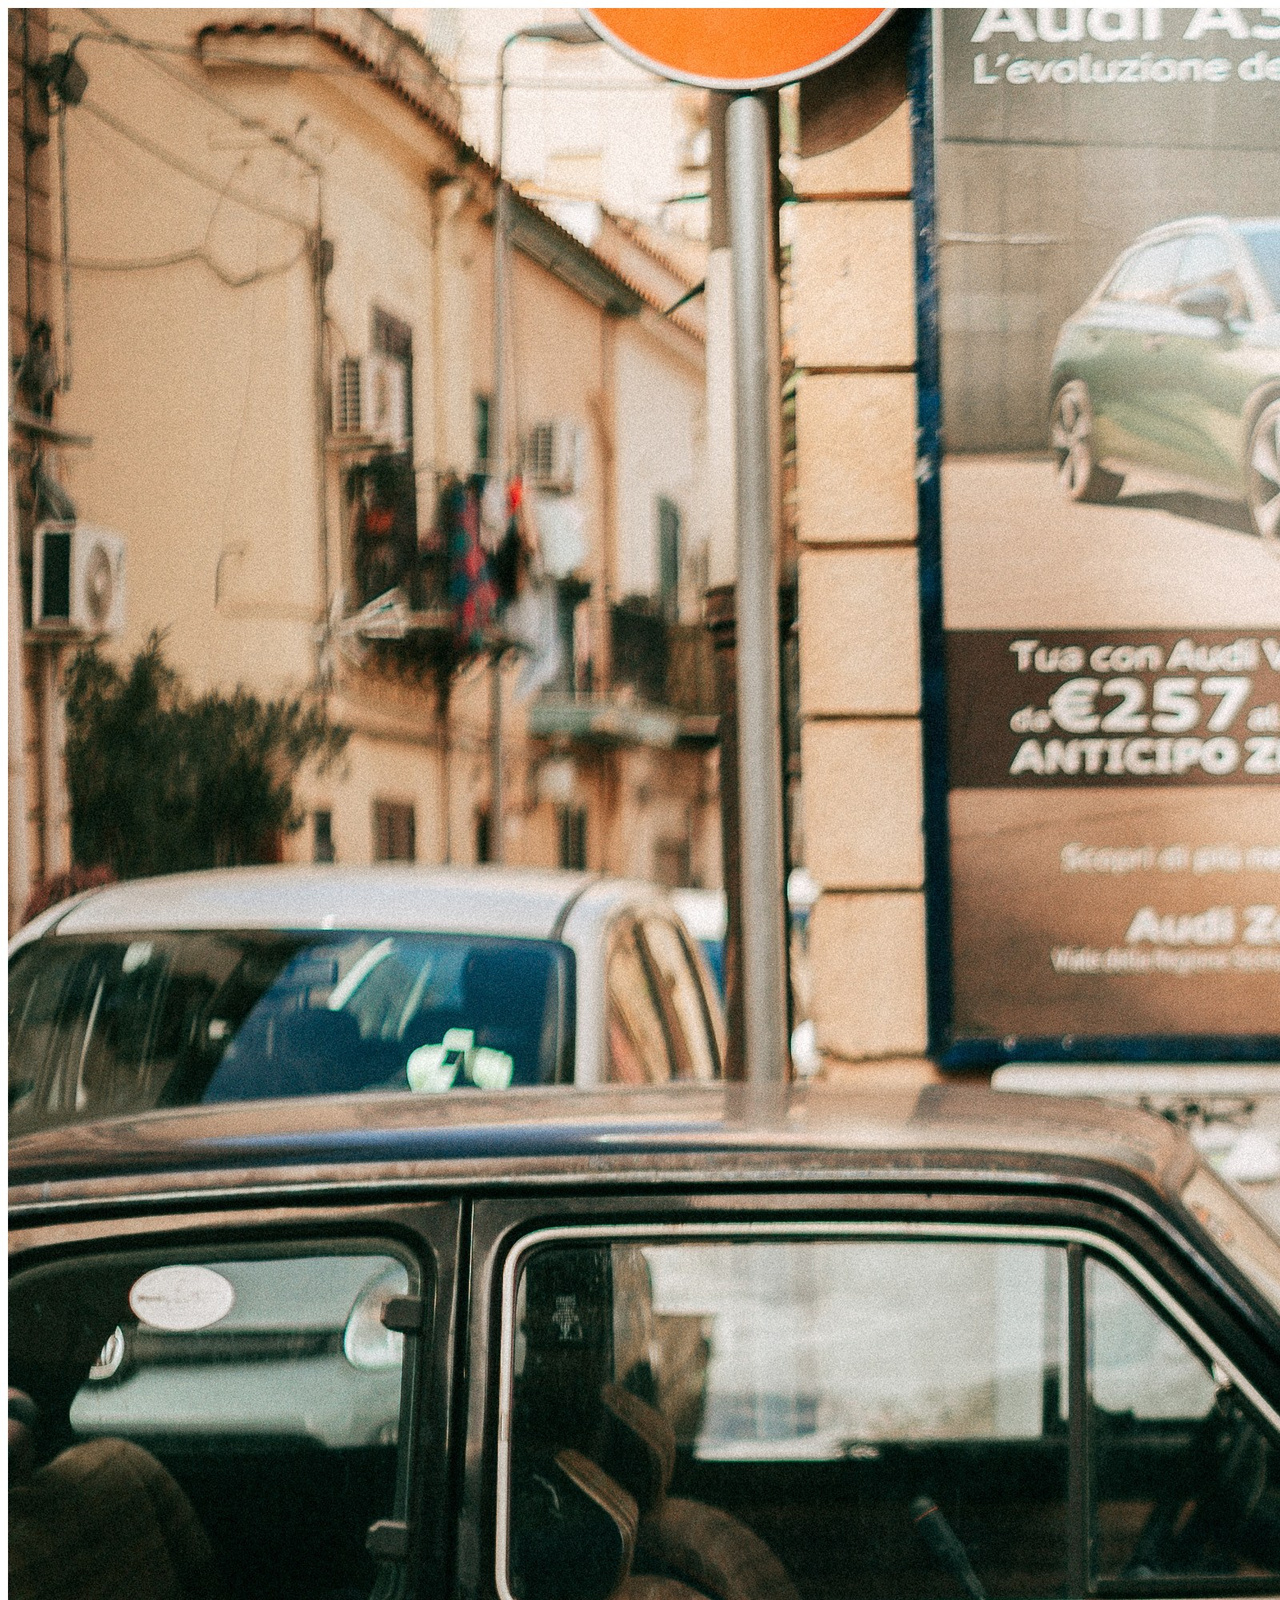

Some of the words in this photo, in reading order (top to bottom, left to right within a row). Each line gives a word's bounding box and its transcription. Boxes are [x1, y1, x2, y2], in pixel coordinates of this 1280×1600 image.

[970, 8, 1163, 42] Audi
[973, 51, 1232, 85] L'evoluzione
[1009, 639, 1085, 672] Tua
[1090, 643, 1164, 672] con
[1166, 637, 1260, 672] Audi
[1049, 676, 1252, 734] €257
[1009, 737, 1241, 776] ANTICIPO
[1060, 841, 1154, 876] Scopri
[1157, 842, 1191, 874] di
[1124, 904, 1236, 946] Audi
